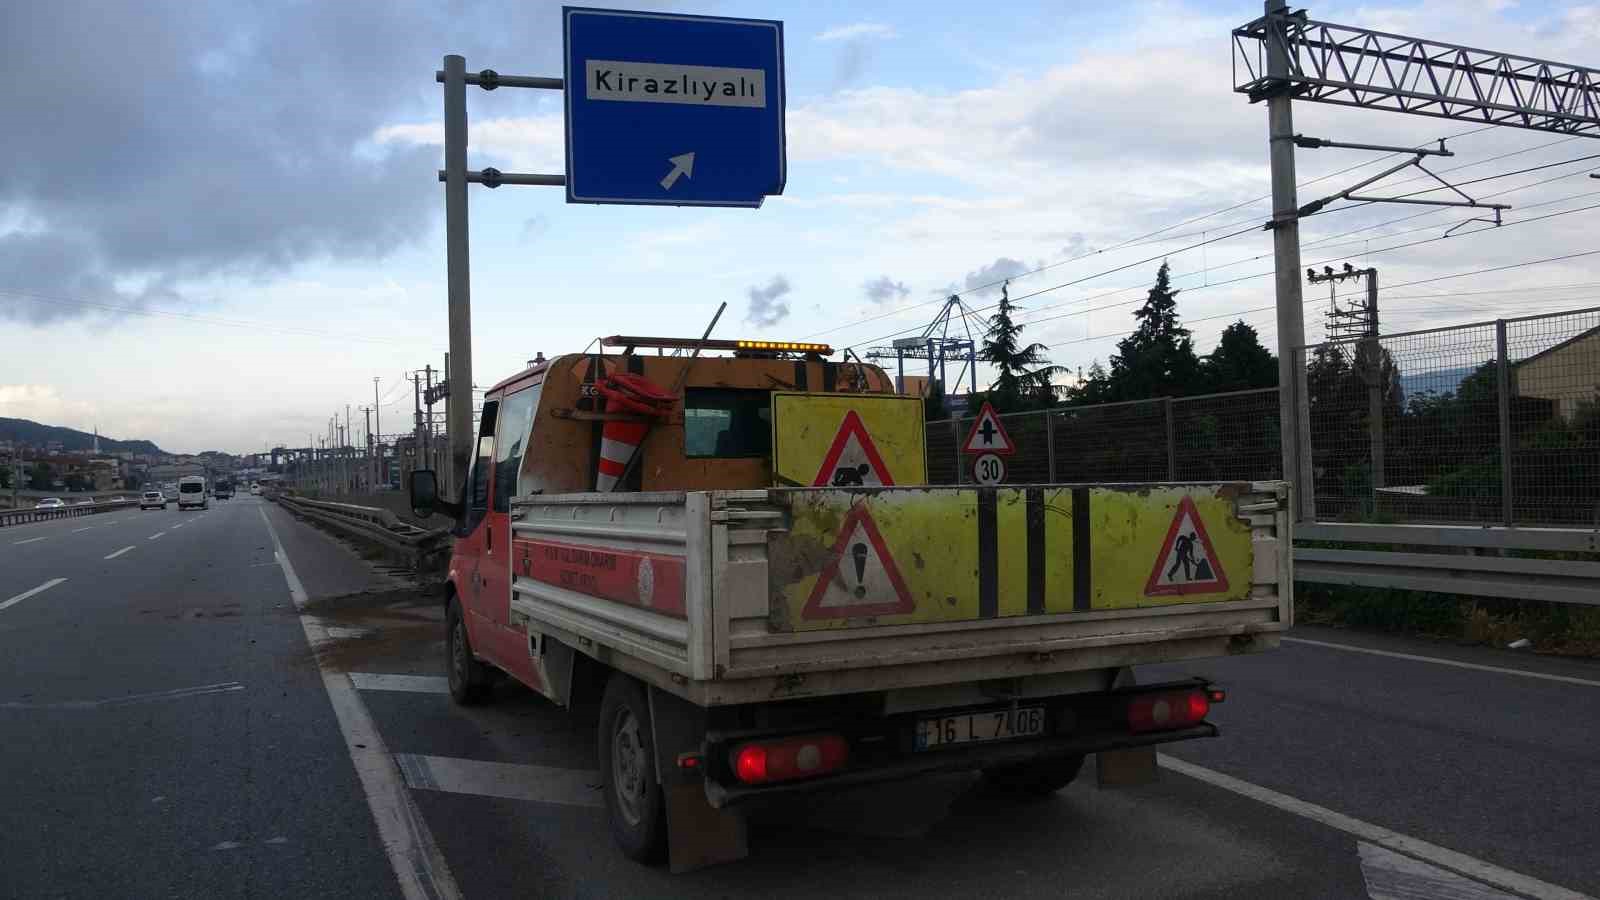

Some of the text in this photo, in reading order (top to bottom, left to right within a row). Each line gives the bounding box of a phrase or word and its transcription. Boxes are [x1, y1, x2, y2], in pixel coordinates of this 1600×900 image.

[595, 69, 756, 100] Kirazlıyalı
[980, 460, 998, 480] 30
[935, 718, 955, 744] 16
[968, 715, 981, 740] L
